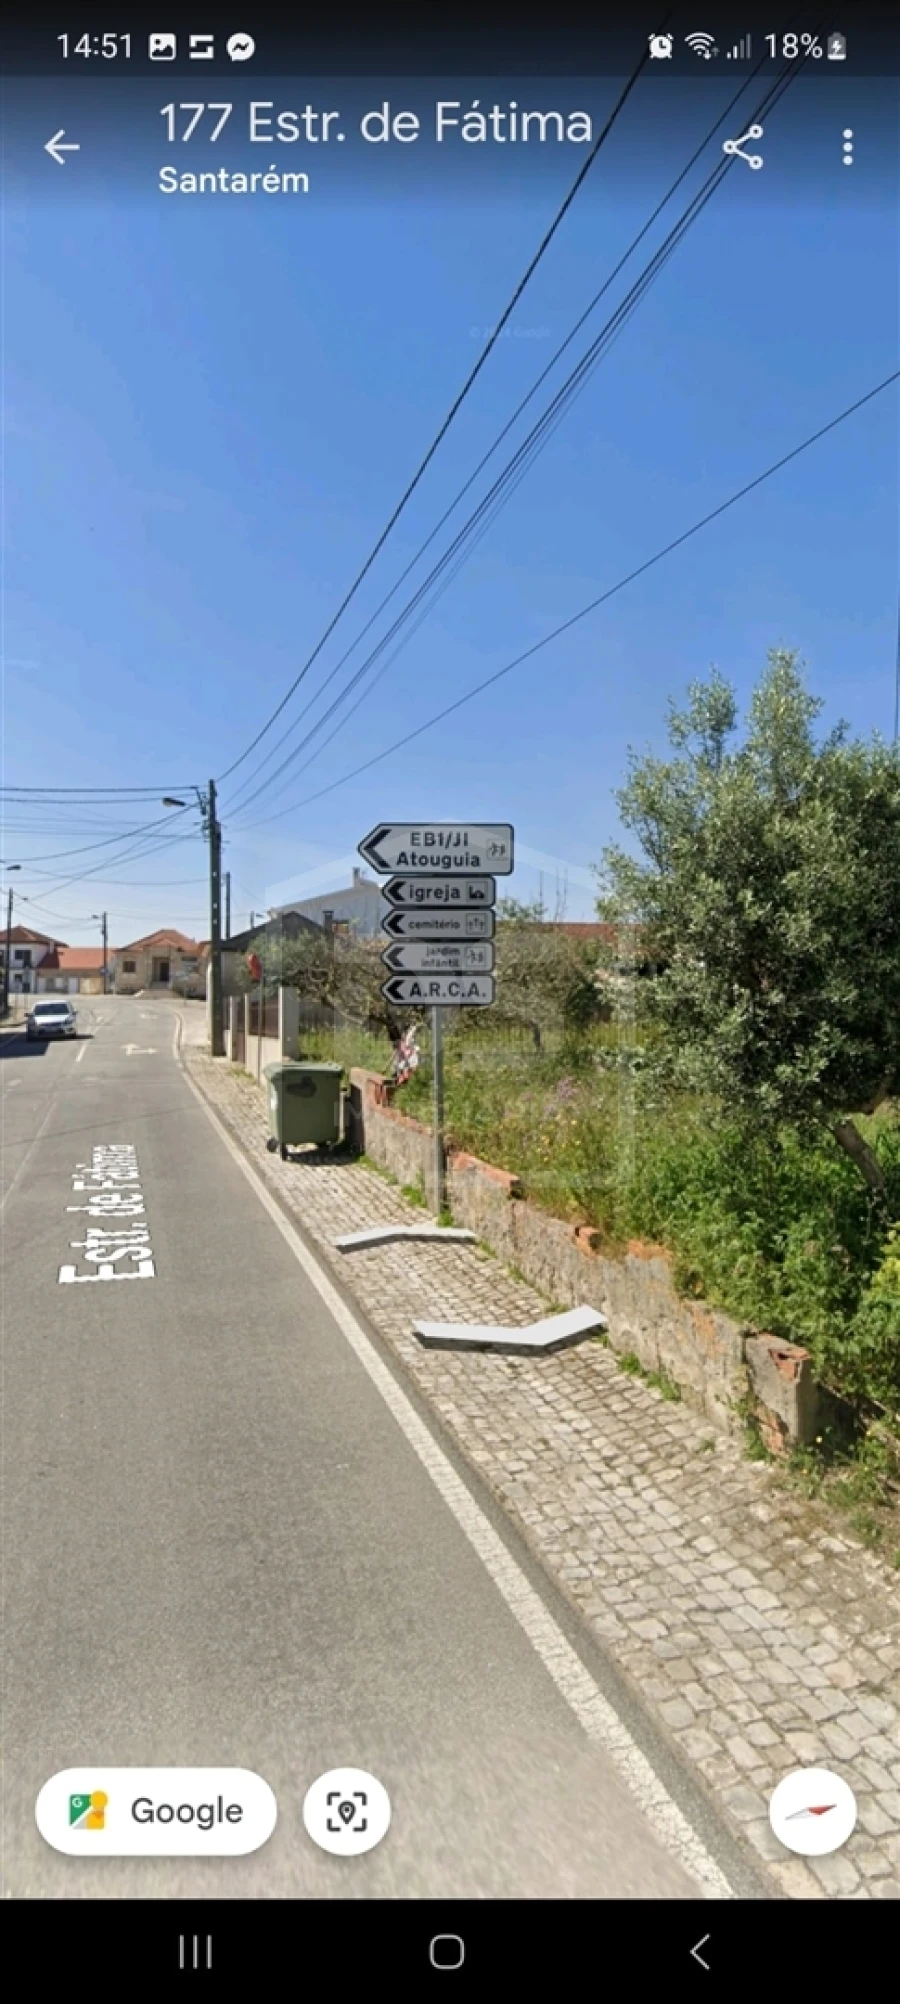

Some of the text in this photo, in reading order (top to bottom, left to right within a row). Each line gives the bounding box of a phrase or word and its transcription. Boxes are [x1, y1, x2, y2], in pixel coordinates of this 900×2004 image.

[409, 831, 469, 849] EB1/JI
[396, 851, 481, 869] Atouguia
[409, 884, 461, 902] igreja
[408, 918, 461, 930] cemitério
[409, 982, 487, 998] A.R.C.A.
